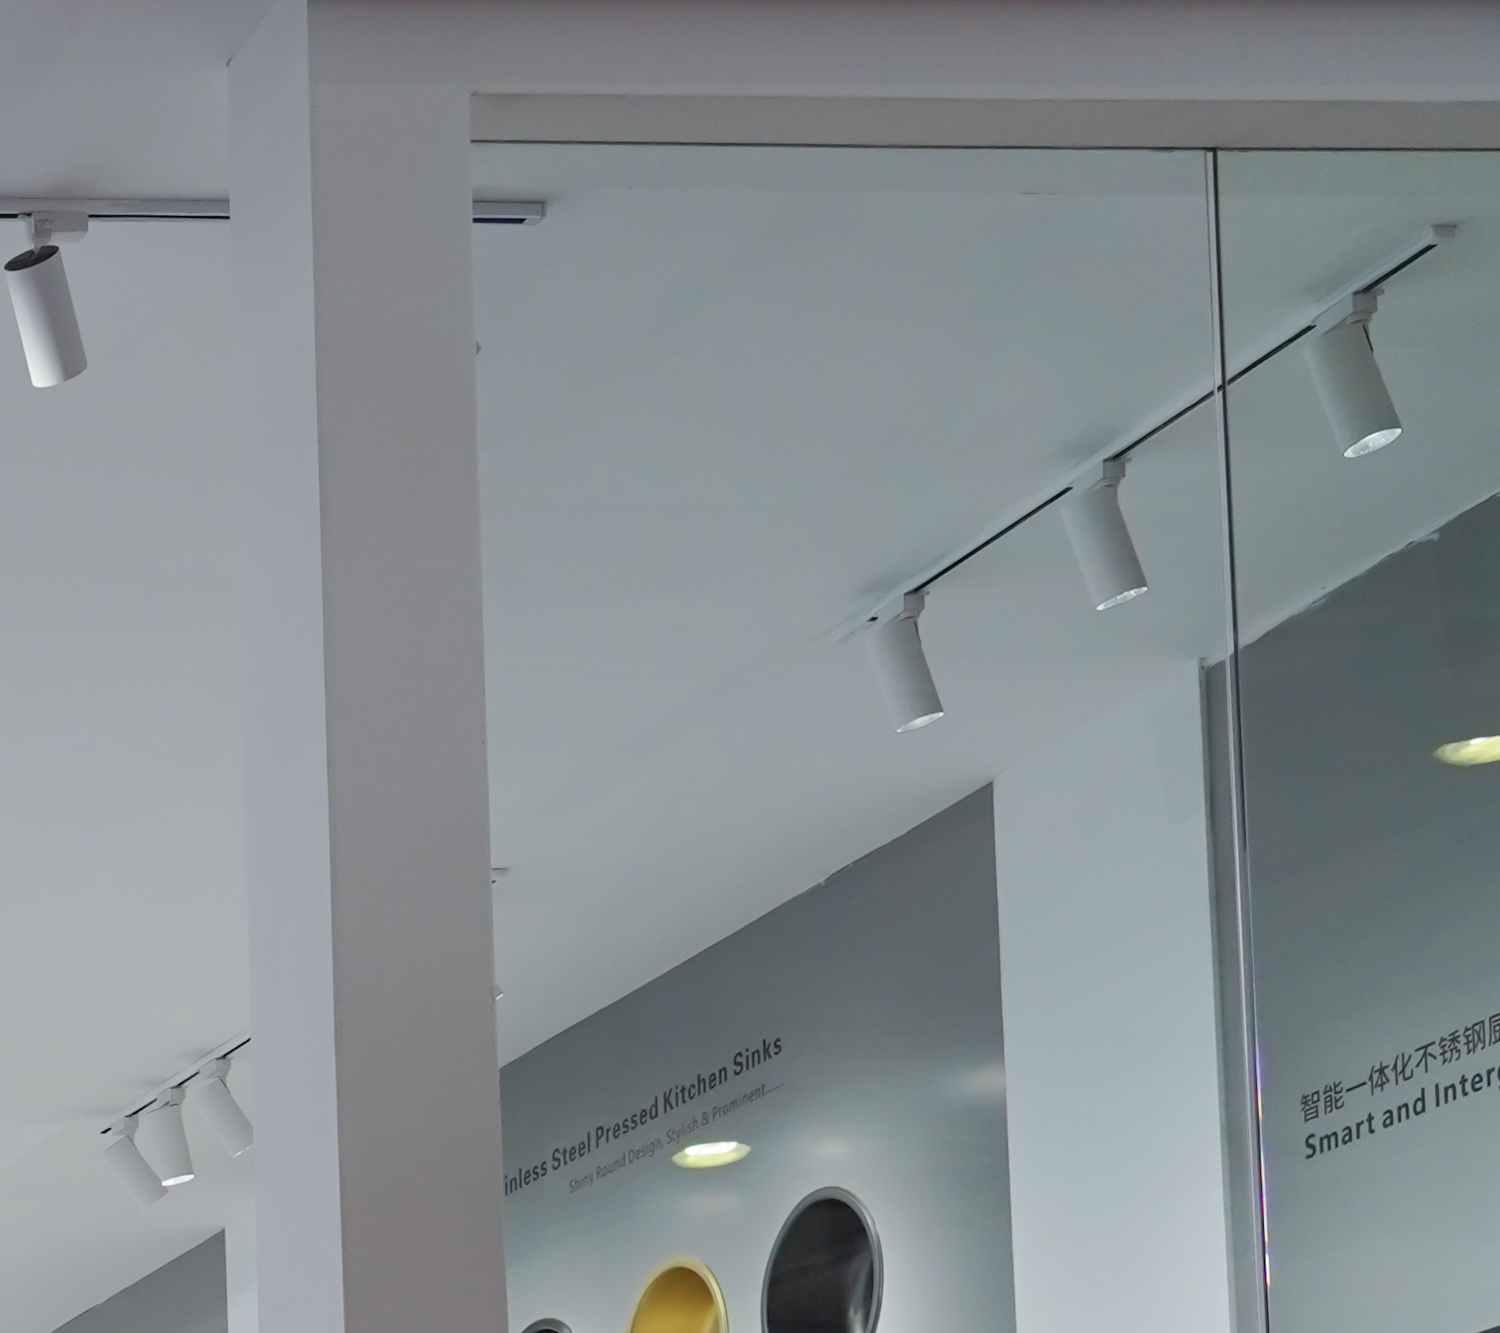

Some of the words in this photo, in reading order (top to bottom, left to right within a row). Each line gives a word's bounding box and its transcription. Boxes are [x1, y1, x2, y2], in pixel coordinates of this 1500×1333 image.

[552, 1131, 591, 1171] Steel
[596, 1096, 658, 1146] Pressed
[663, 1066, 728, 1113] Kitchen
[733, 1037, 782, 1076] Sinks
[1305, 1112, 1375, 1160] Smart
[1382, 1087, 1426, 1128] and
[1435, 1065, 1500, 1108] Inter
